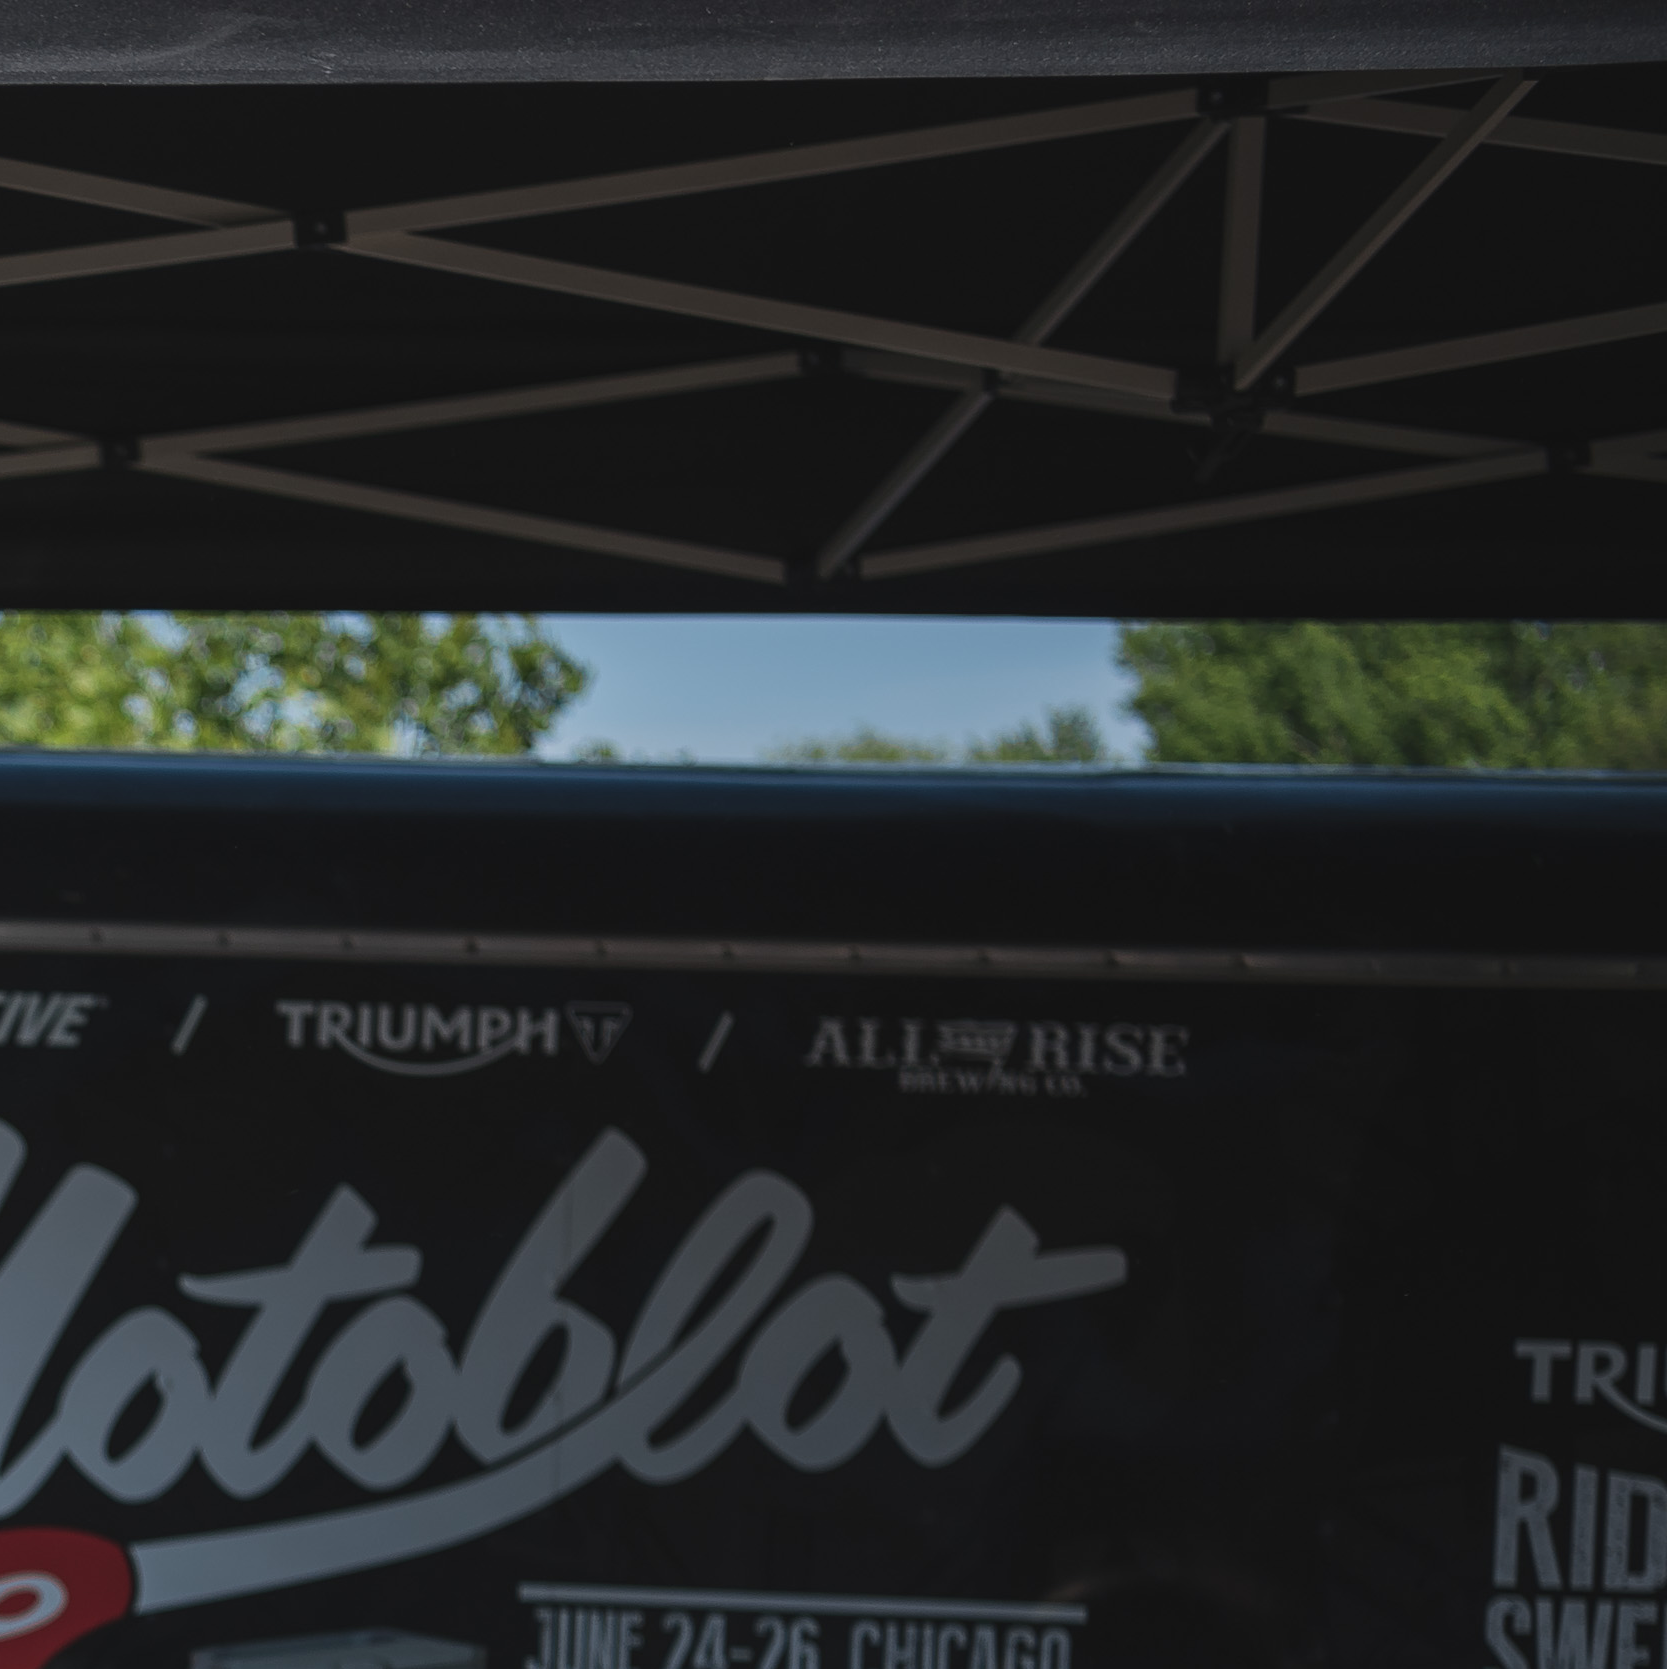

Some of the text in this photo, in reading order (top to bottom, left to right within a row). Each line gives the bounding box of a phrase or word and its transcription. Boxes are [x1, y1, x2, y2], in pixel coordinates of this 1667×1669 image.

[277, 1000, 559, 1076] TRIUMPH
[805, 1016, 940, 1068] ALL
[1027, 1020, 1189, 1076] RISE
[1514, 1339, 1667, 1433] TRI
